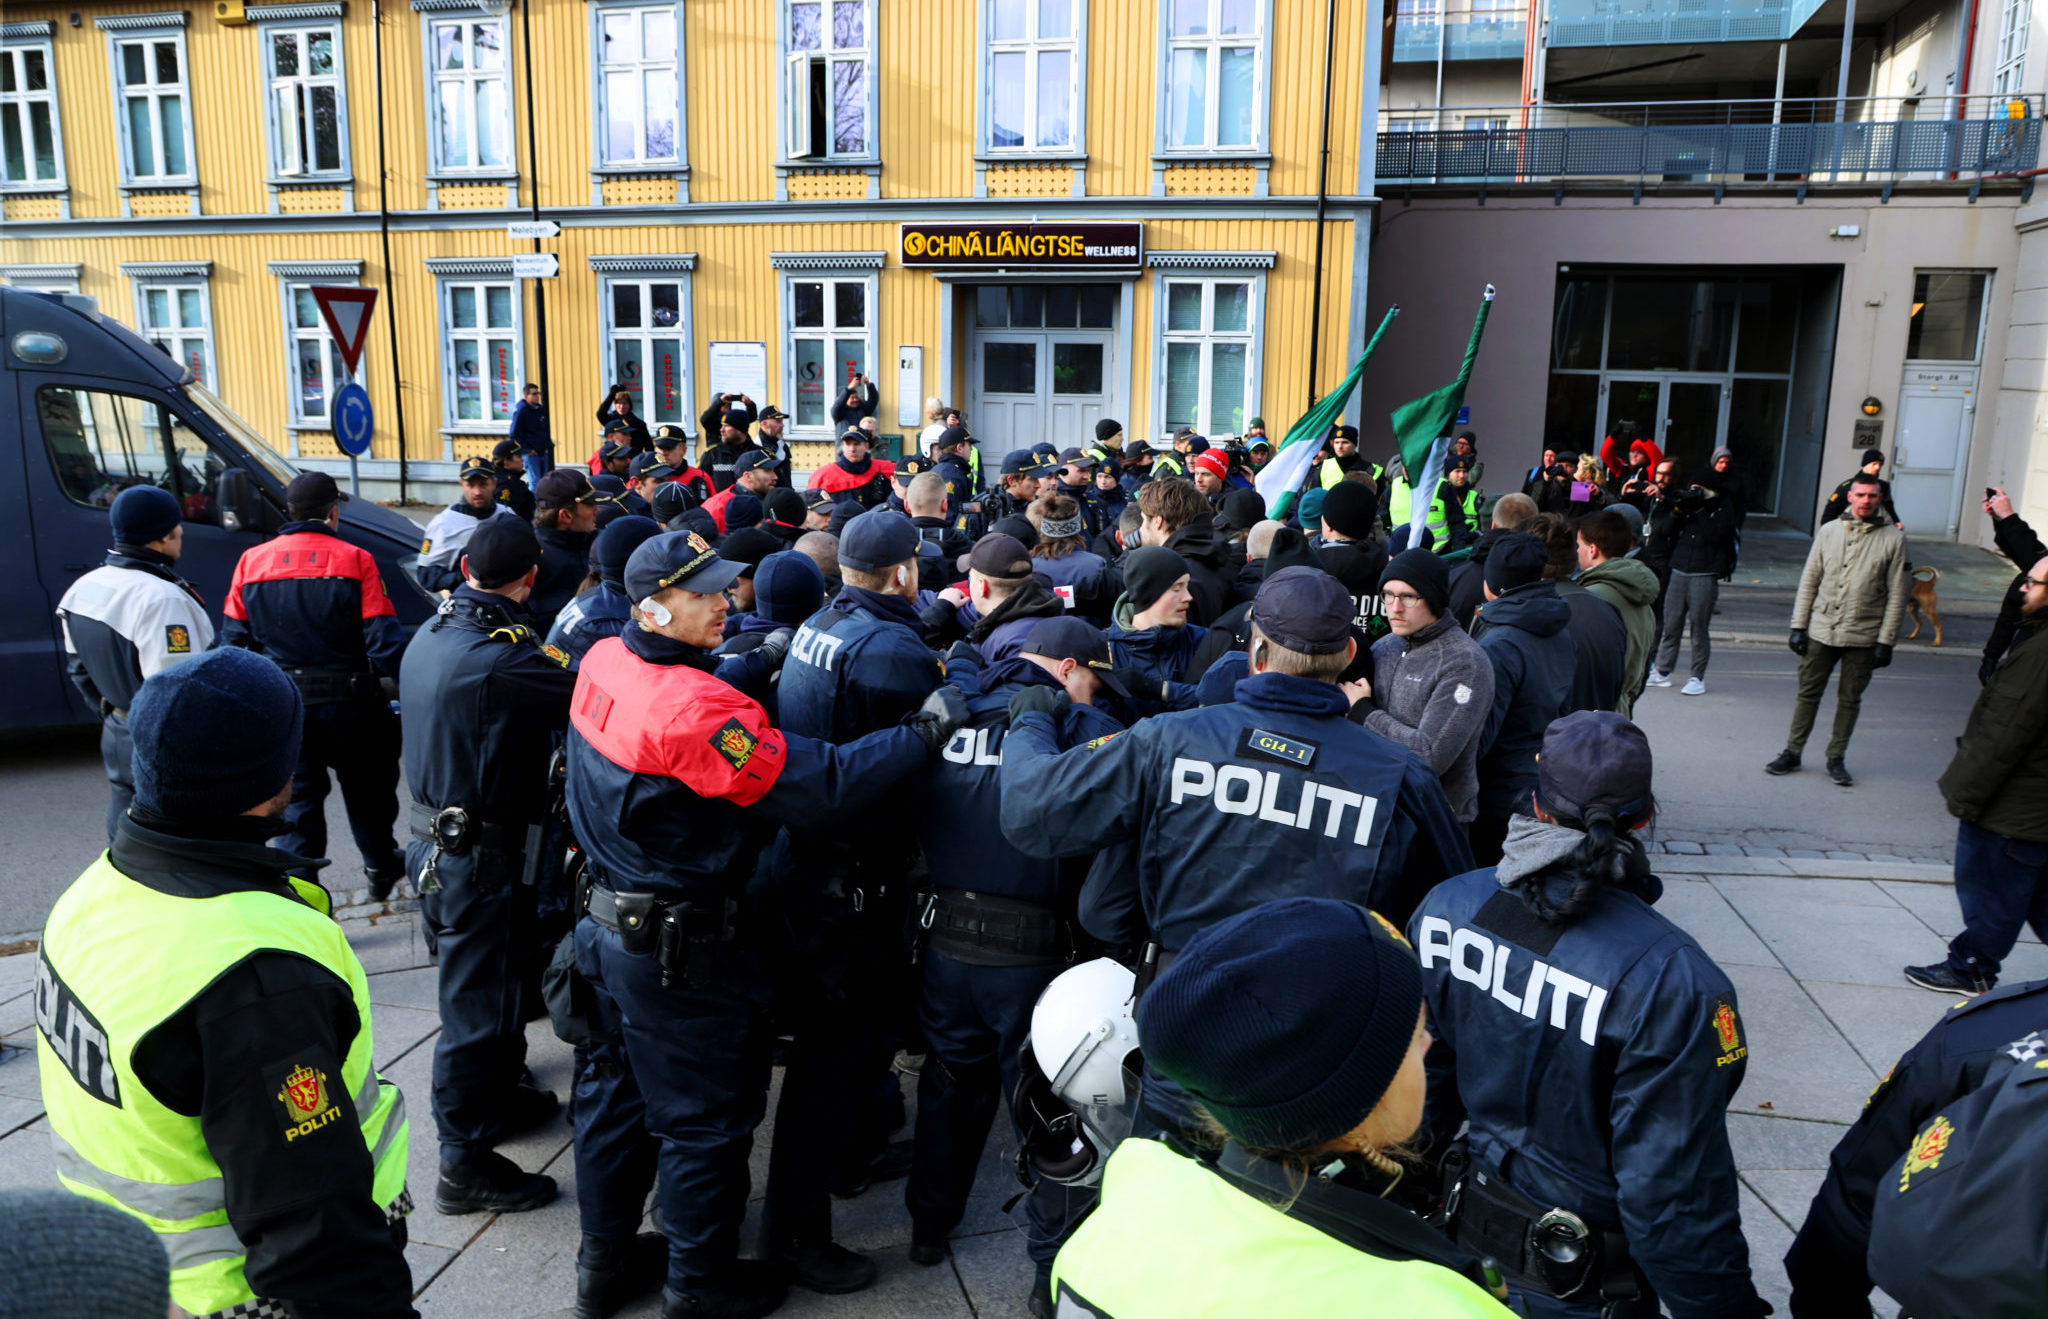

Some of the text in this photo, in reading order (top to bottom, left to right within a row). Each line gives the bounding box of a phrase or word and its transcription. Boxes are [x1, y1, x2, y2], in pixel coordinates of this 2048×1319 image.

[1085, 246, 1137, 257] WELLNESS
[1859, 434, 1876, 446] 28
[791, 623, 844, 672] OLITI
[1171, 757, 1378, 846] POLITI
[1419, 915, 1608, 1046] POLITI
[34, 945, 116, 1101] OLITI
[285, 1105, 341, 1142] POLITI
